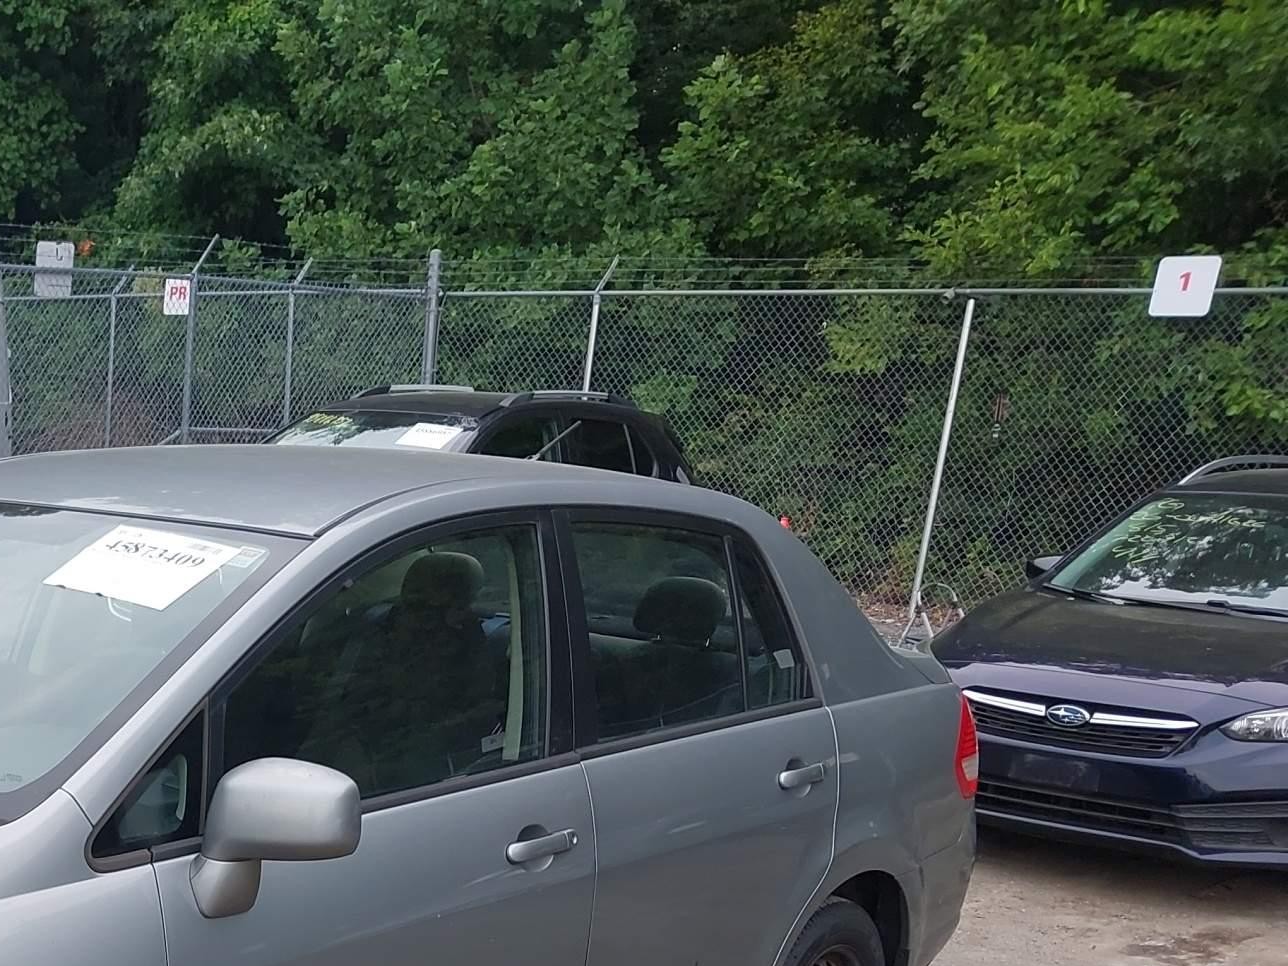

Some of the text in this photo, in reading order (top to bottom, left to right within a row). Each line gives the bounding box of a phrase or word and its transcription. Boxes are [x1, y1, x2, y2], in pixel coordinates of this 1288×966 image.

[1179, 271, 1192, 292] 1
[169, 286, 187, 301] PR
[105, 539, 206, 568] 45873409
